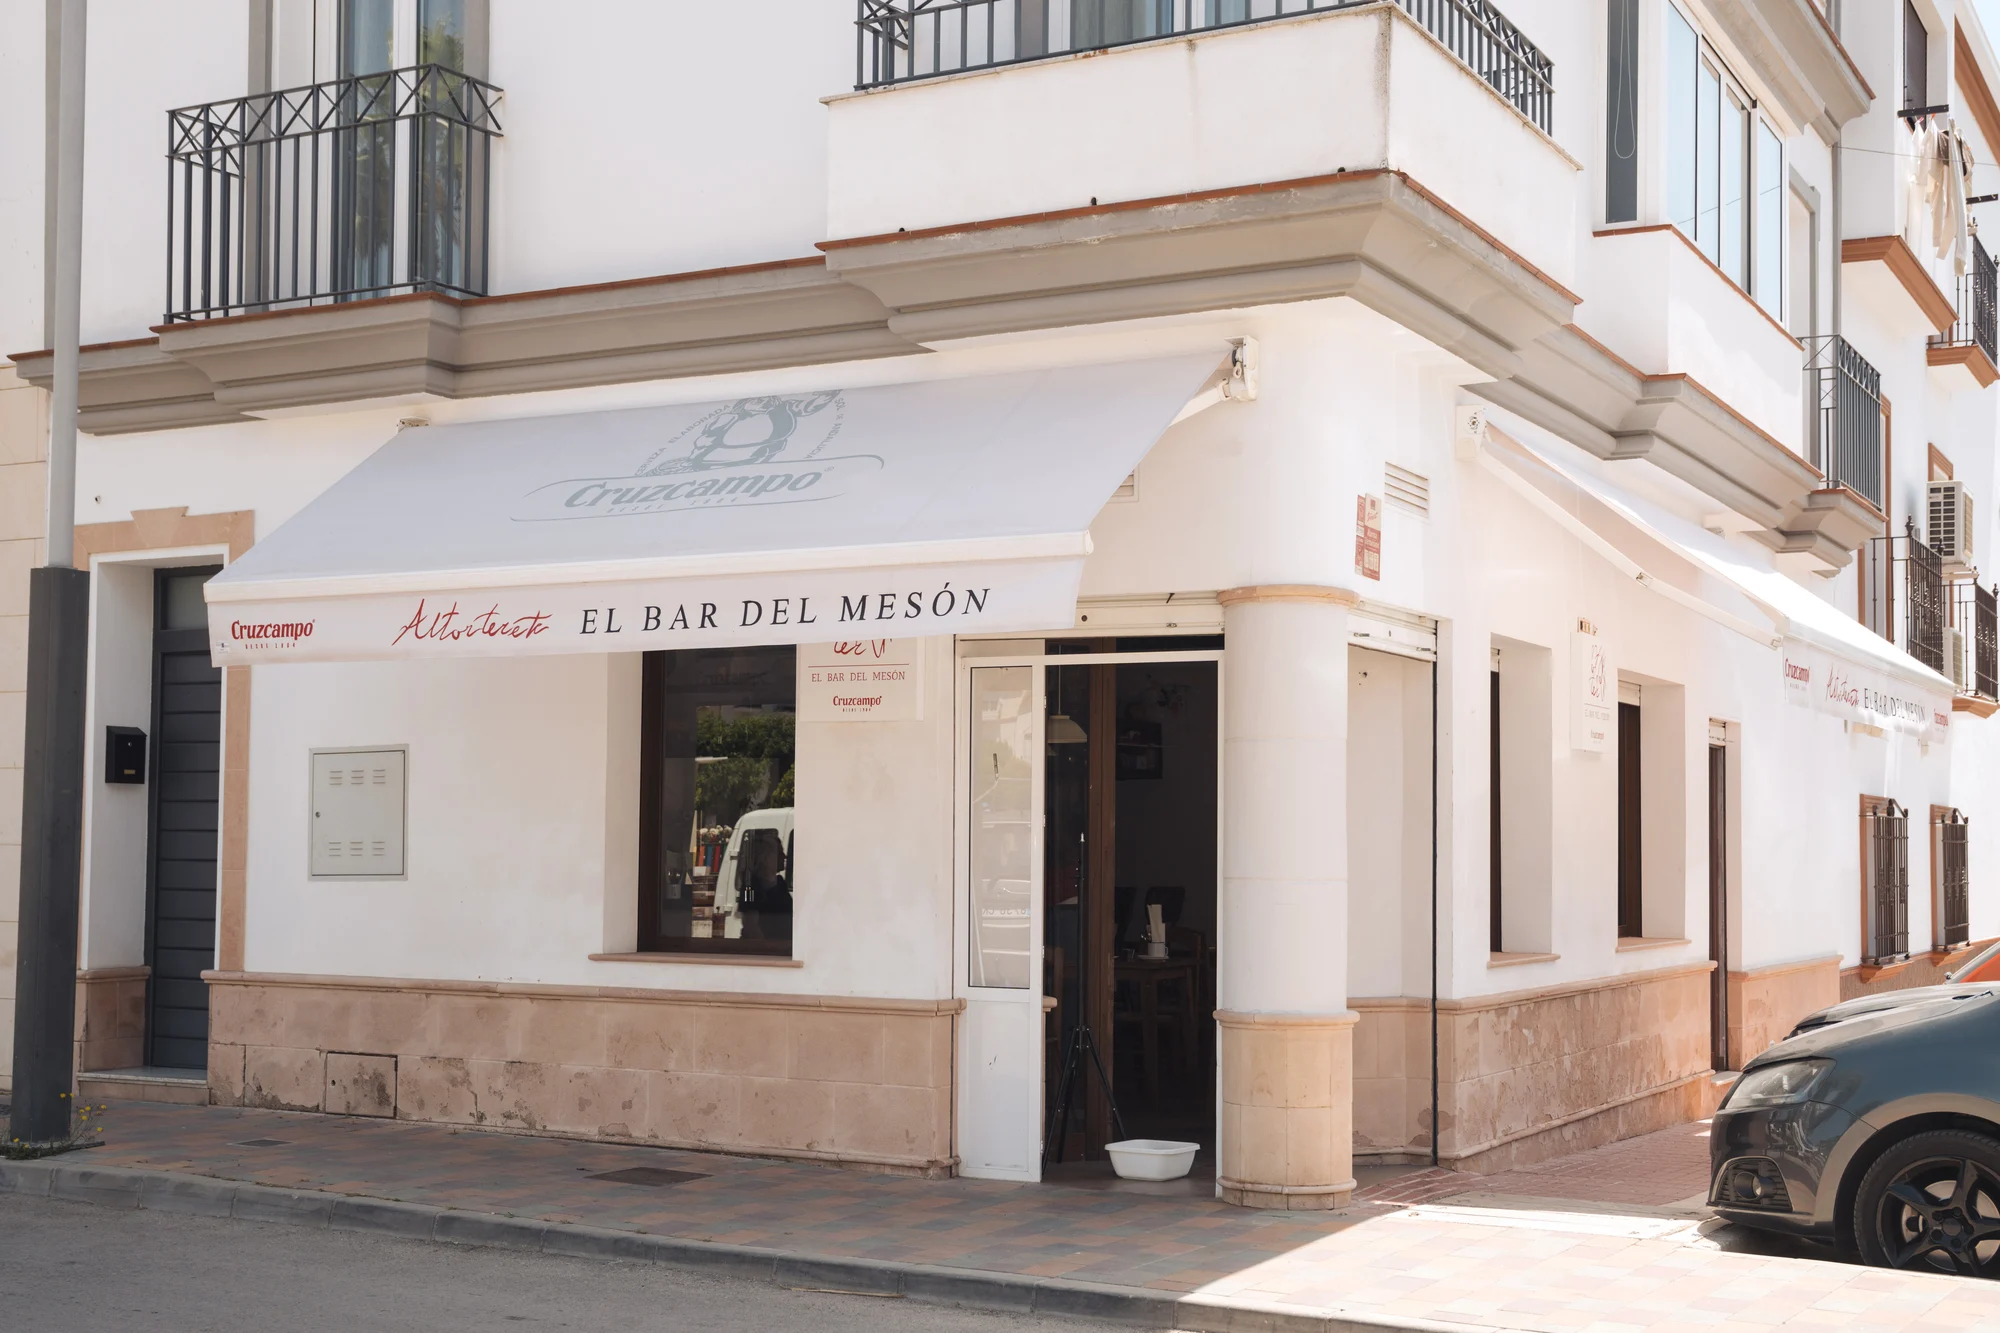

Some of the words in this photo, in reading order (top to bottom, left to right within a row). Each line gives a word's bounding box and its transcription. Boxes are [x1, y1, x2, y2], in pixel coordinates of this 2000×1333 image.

[668, 404, 730, 444] ELABORADA
[564, 471, 822, 508] Cruzcampo
[580, 607, 622, 635] EL
[641, 603, 718, 632] BAR
[739, 597, 817, 627] DEL
[838, 582, 990, 622] MESÓN
[231, 619, 313, 641] Cruzcampo
[811, 673, 822, 682] EL
[827, 672, 845, 682] BAR
[850, 672, 868, 682] DEL
[872, 669, 905, 681] MESÓN
[832, 695, 881, 708] Cruzcampo
[1874, 691, 1889, 716] BAR
